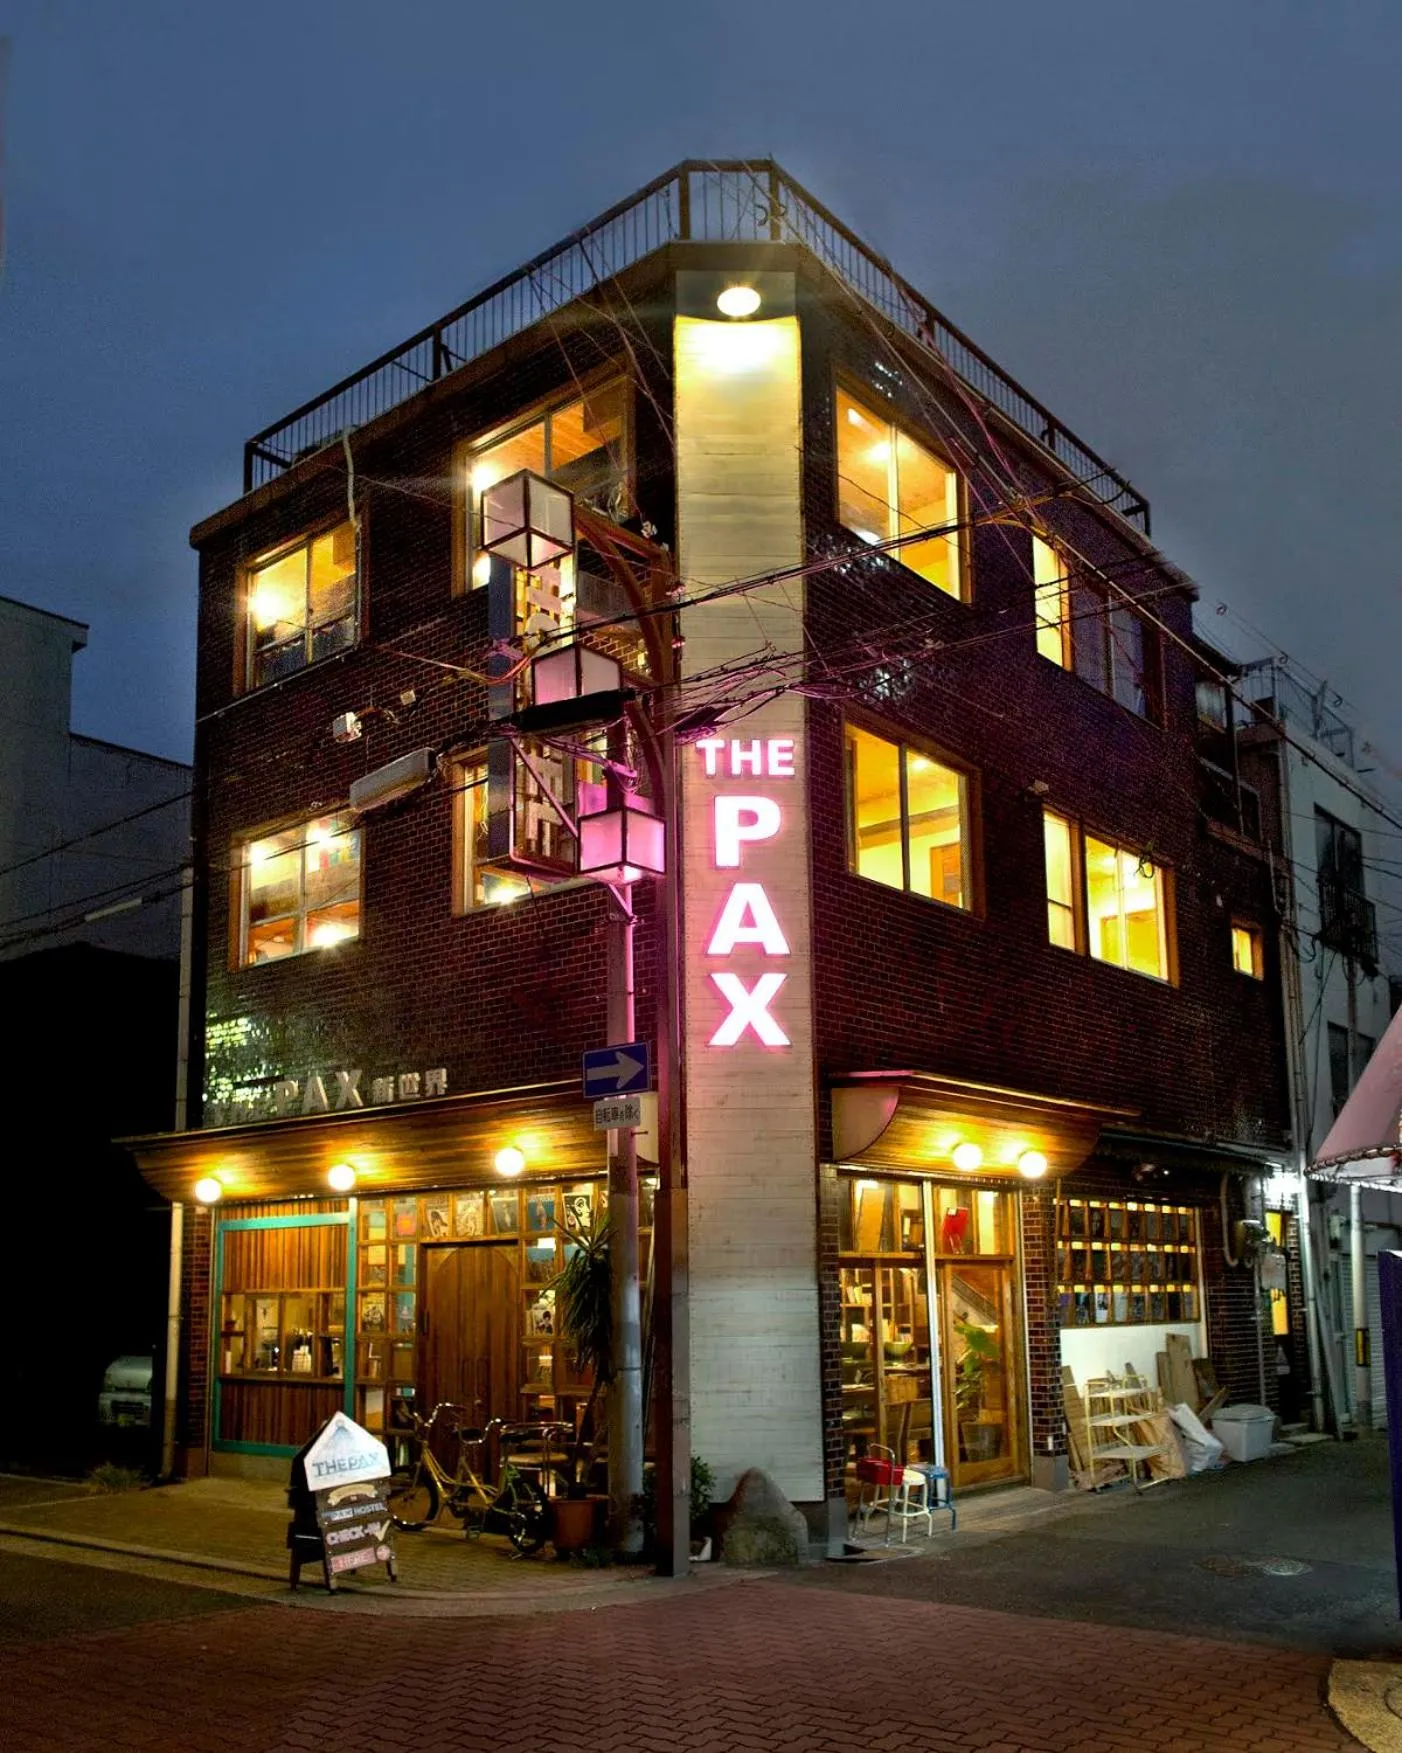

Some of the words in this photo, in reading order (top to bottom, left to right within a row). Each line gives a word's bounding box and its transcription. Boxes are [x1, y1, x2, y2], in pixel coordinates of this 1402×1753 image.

[695, 739, 795, 777] THE
[706, 795, 792, 1048] PAX
[275, 1068, 364, 1116] PAX
[371, 1067, 448, 1105] 新世界
